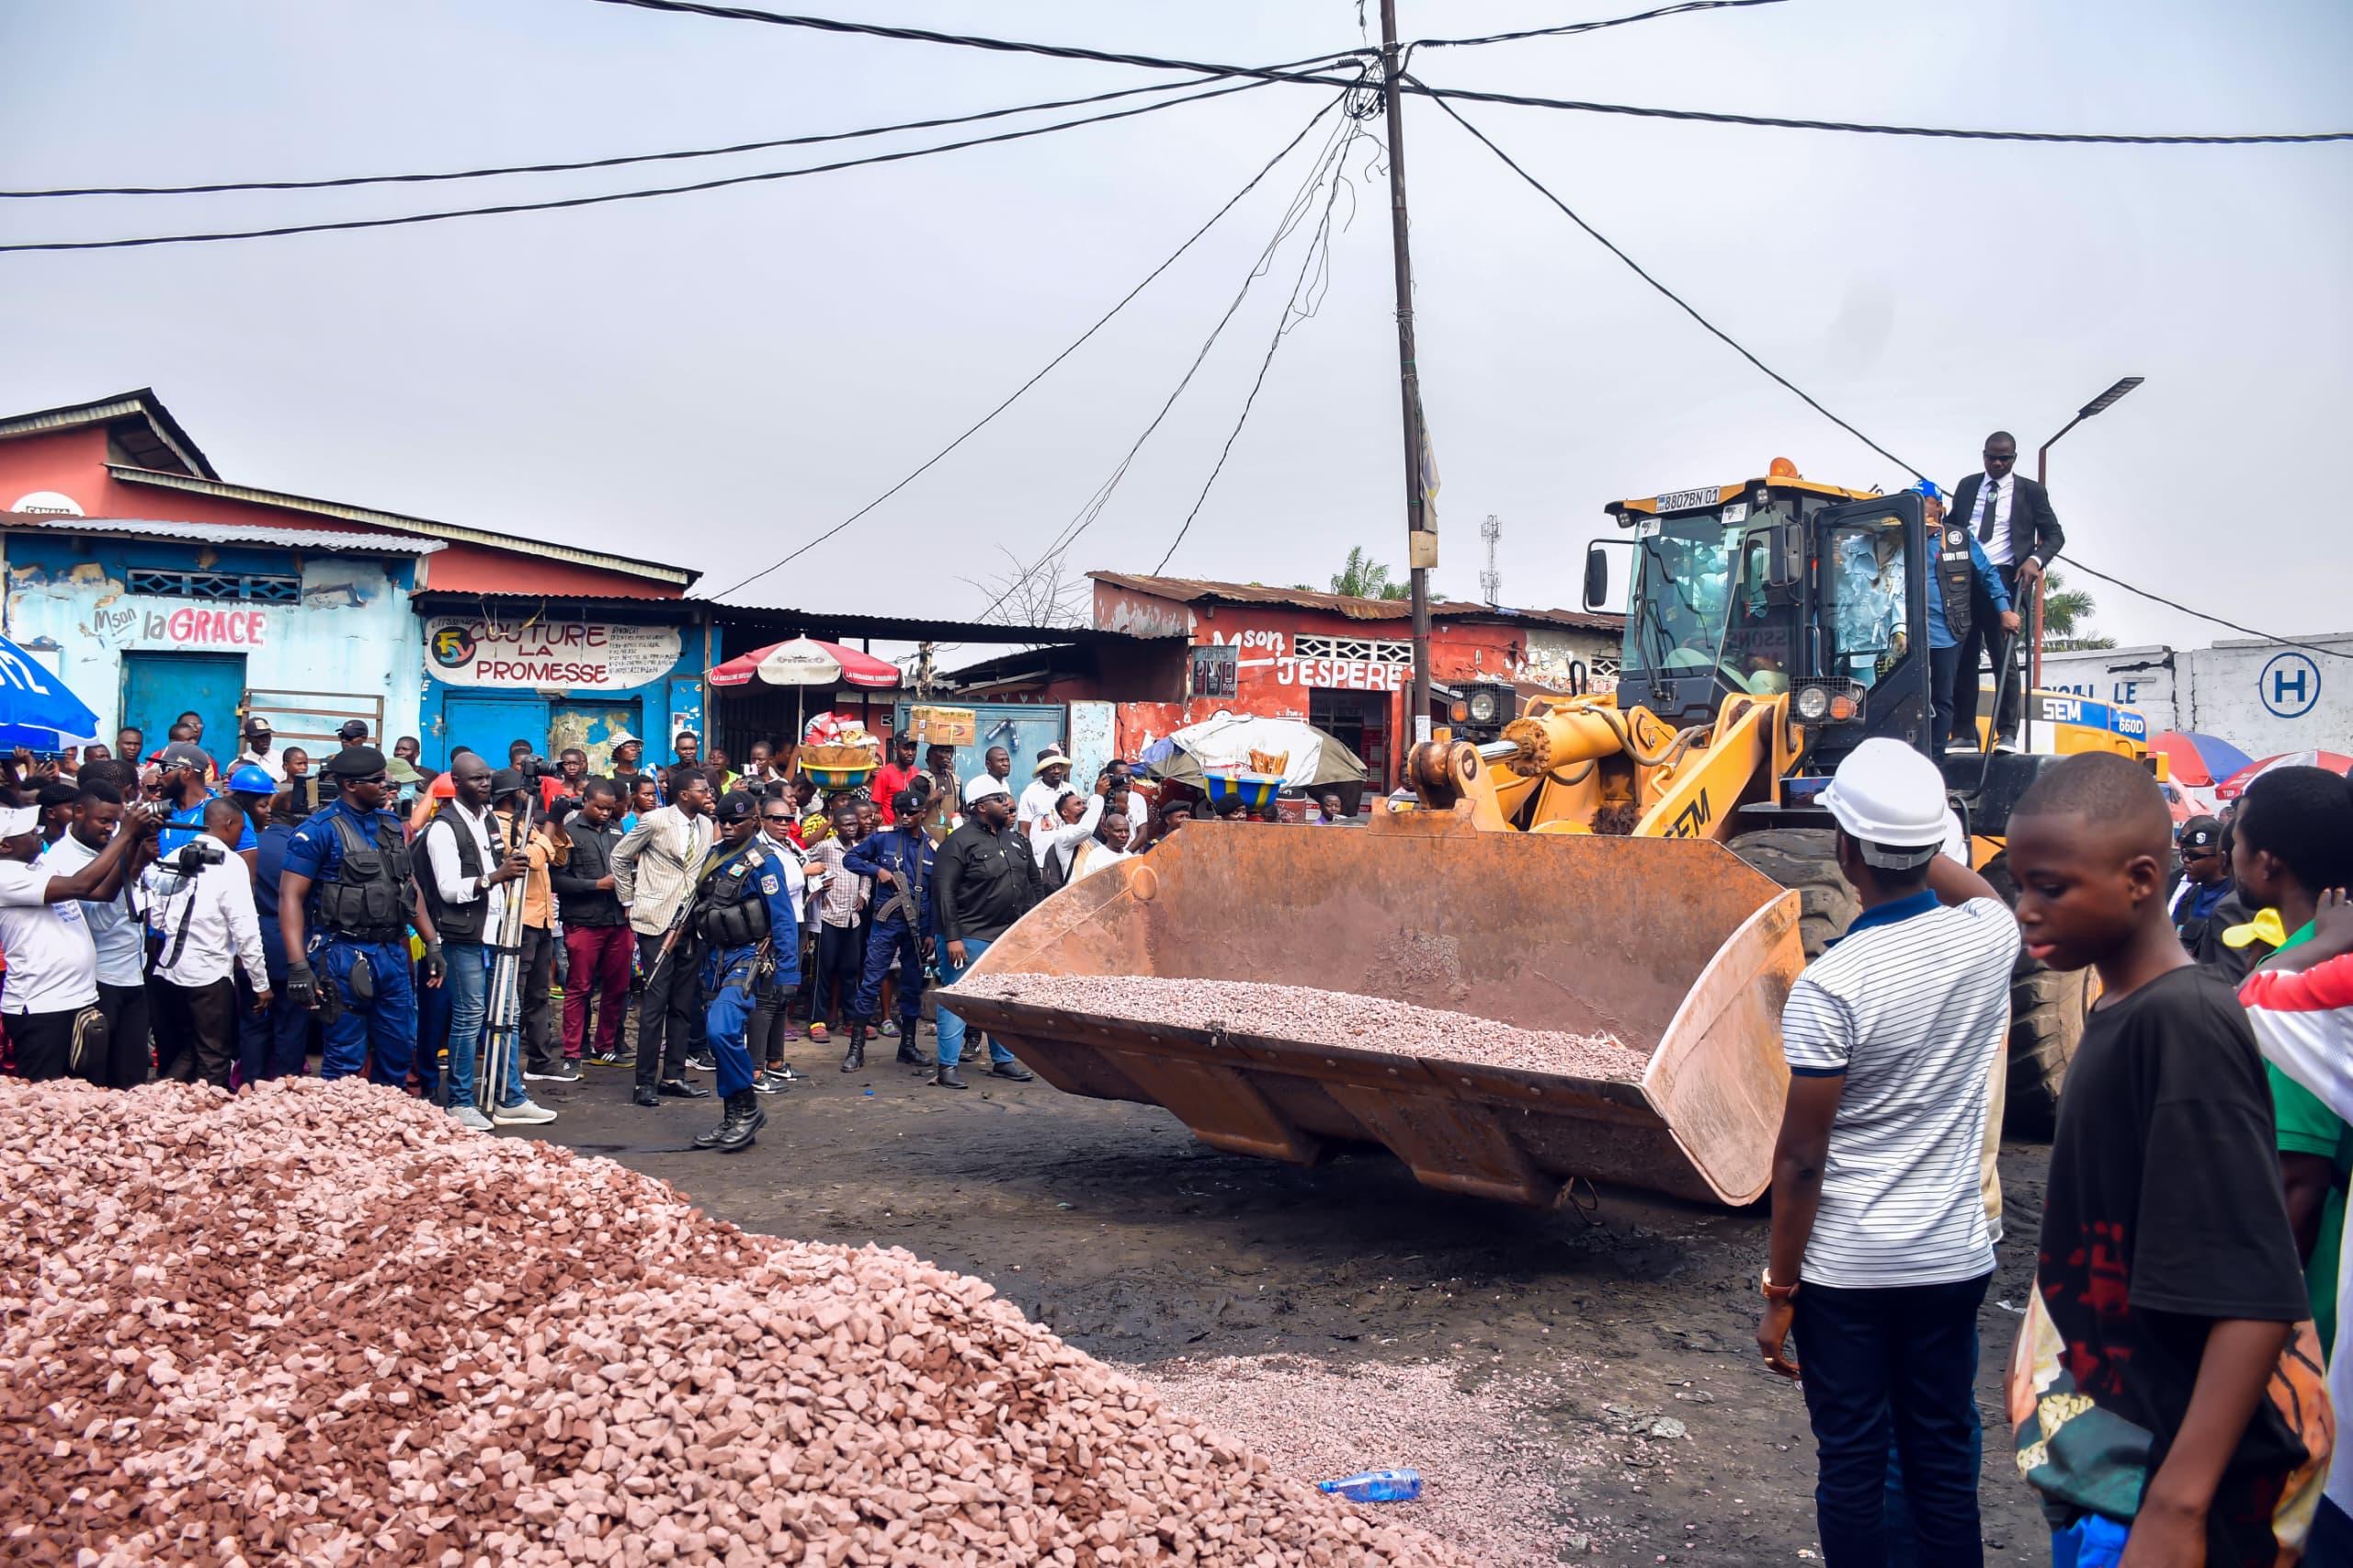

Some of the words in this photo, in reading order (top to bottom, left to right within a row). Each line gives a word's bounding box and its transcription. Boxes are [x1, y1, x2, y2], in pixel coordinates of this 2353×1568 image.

[1665, 492, 1704, 510] 8807BN
[1705, 488, 1719, 505] 01
[167, 608, 266, 646] GRACE
[470, 620, 608, 647] COUTURE
[517, 644, 553, 657] LA
[476, 660, 610, 684] PROMESSE
[2274, 669, 2306, 703] H
[2042, 699, 2082, 722] SEM
[2118, 716, 2144, 734] 660D
